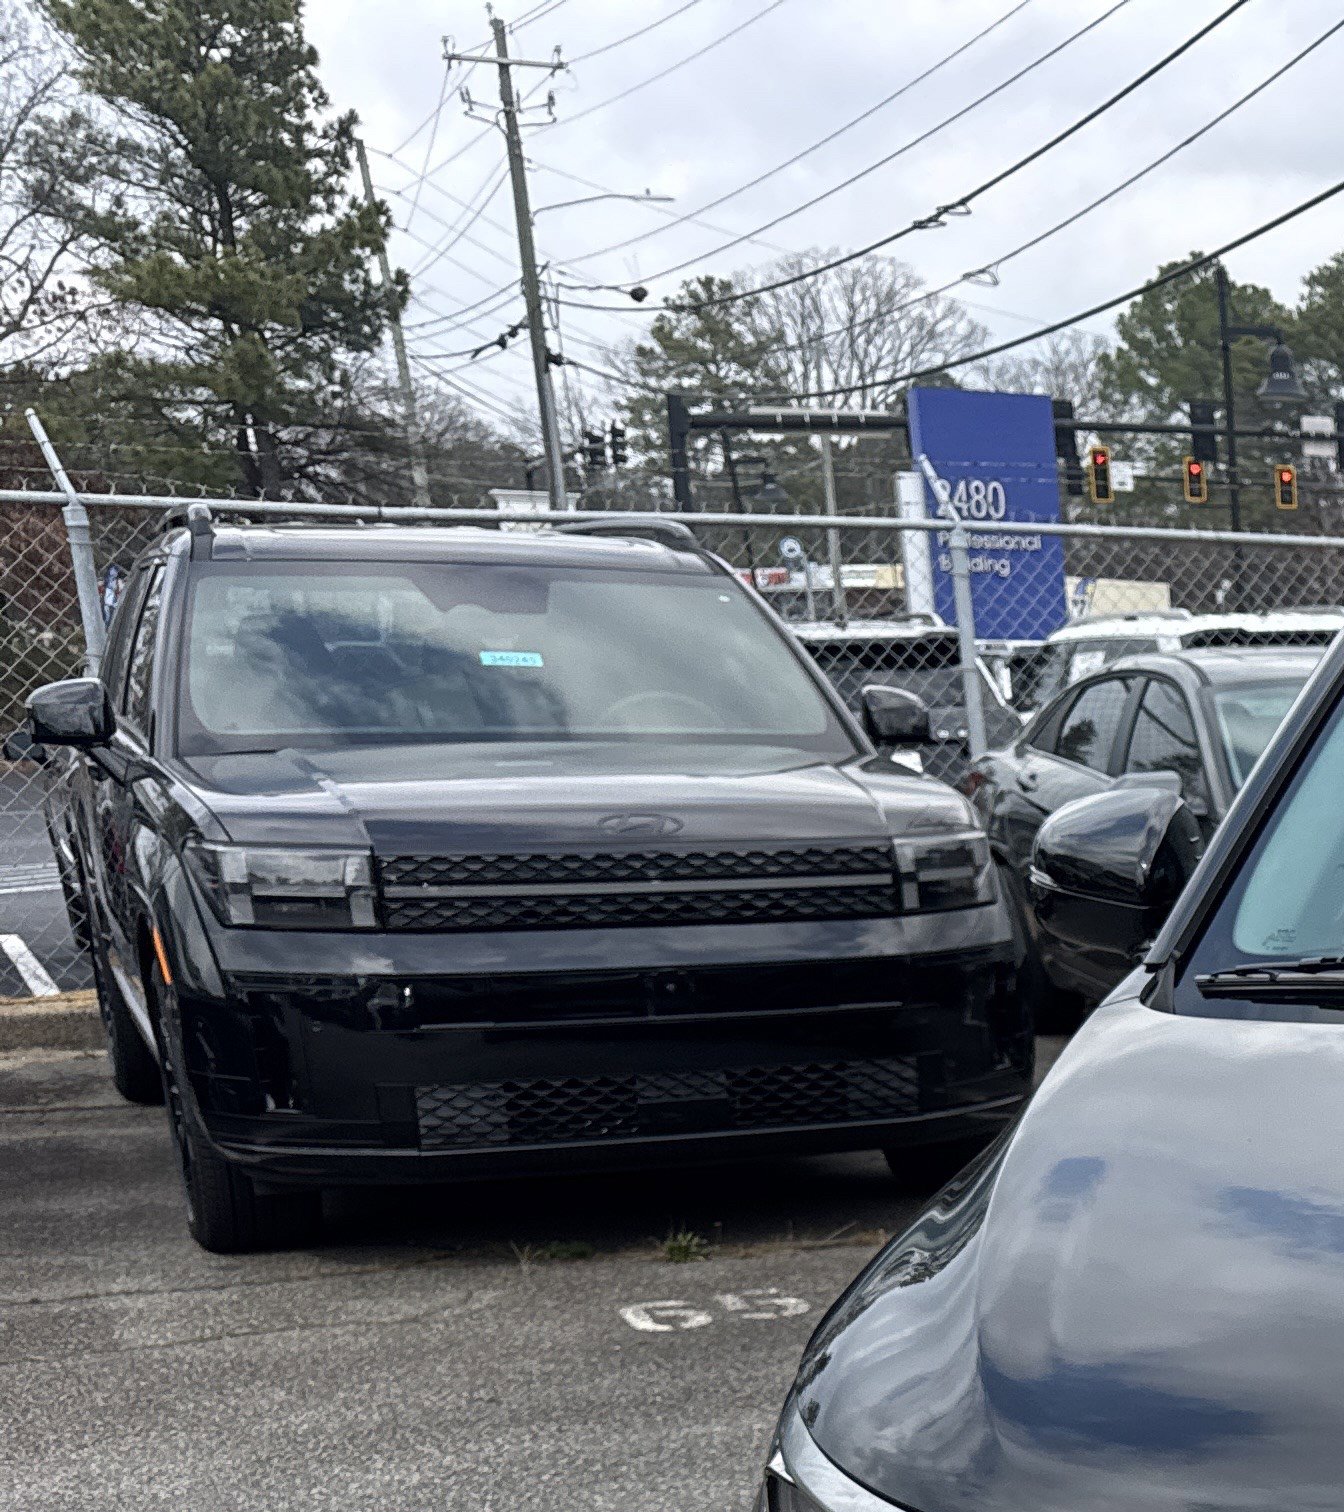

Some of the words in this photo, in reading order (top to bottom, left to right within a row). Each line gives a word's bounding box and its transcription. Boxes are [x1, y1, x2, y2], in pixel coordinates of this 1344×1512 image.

[936, 530, 1042, 551] Pessional
[938, 553, 1011, 577] Bding
[618, 1287, 812, 1333] 65
